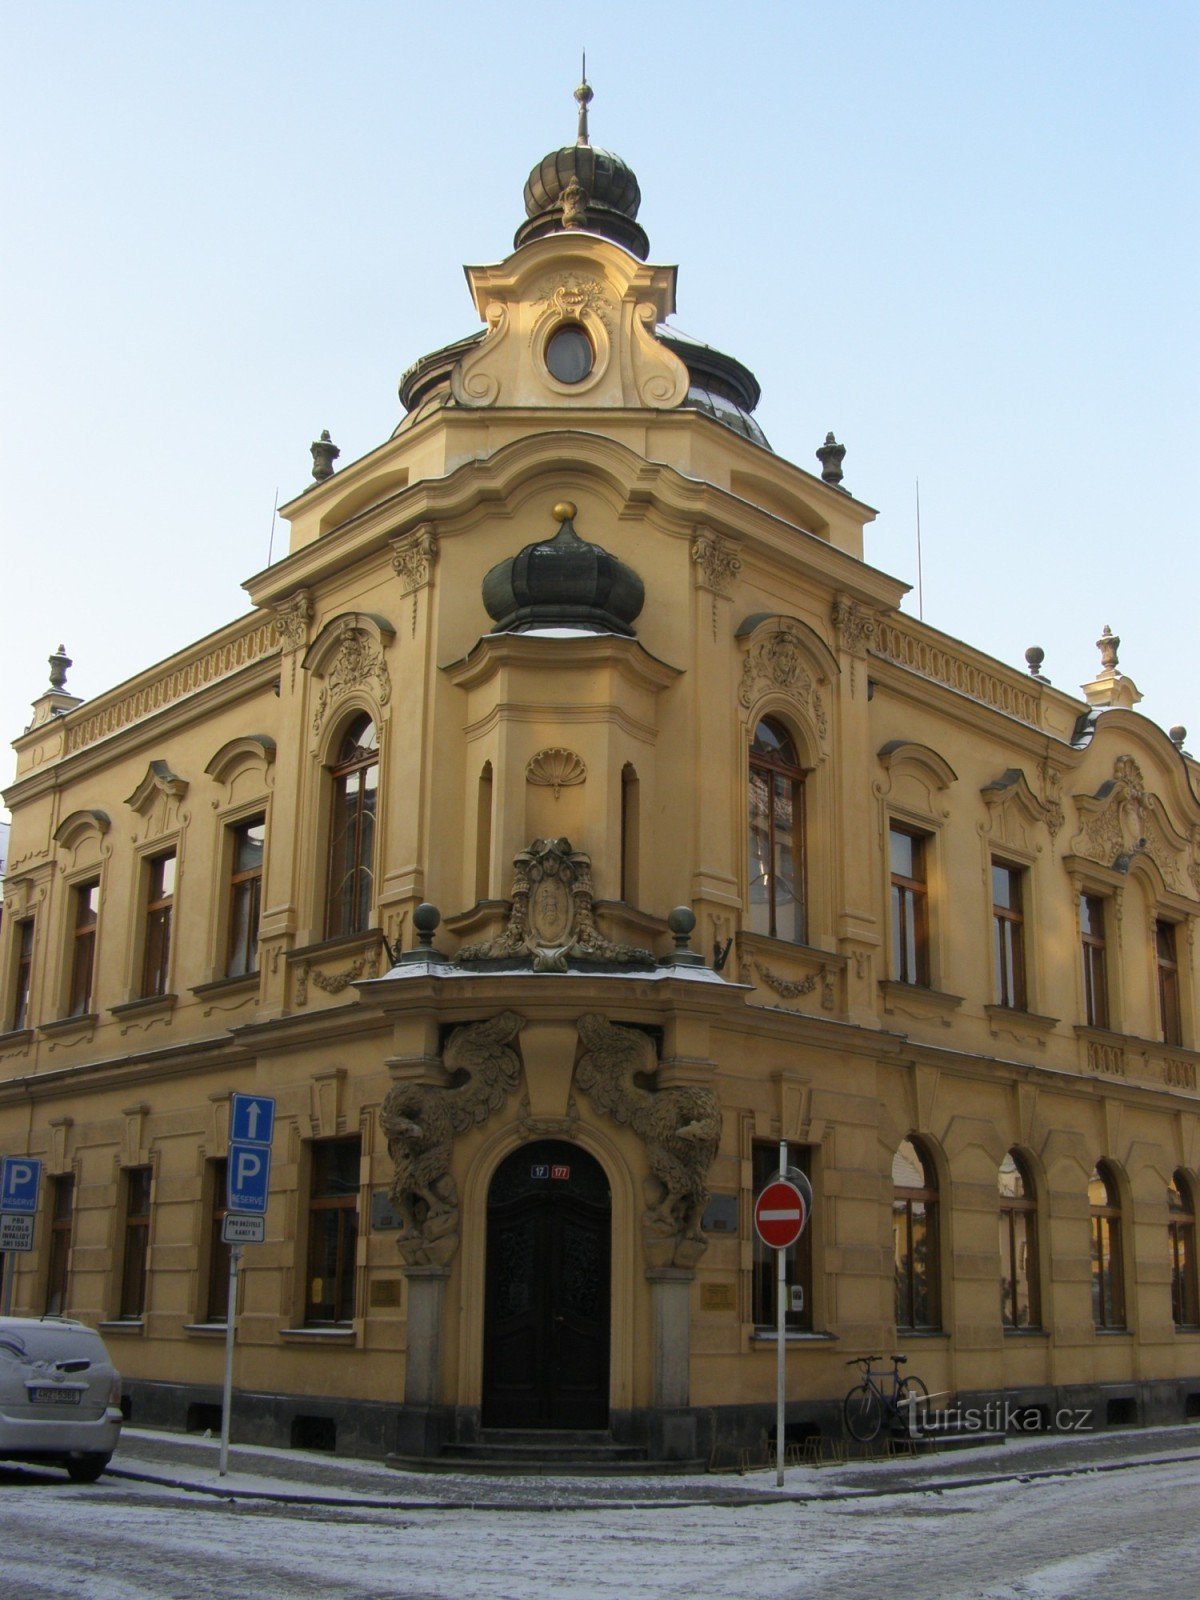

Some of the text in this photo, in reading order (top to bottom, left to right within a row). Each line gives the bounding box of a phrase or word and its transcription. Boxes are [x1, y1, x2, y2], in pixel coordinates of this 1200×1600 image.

[237, 1152, 261, 1189] P
[536, 1166, 544, 1177] 17
[555, 1167, 567, 1177] 177
[9, 1165, 32, 1194] P
[12, 1217, 25, 1225] PRO
